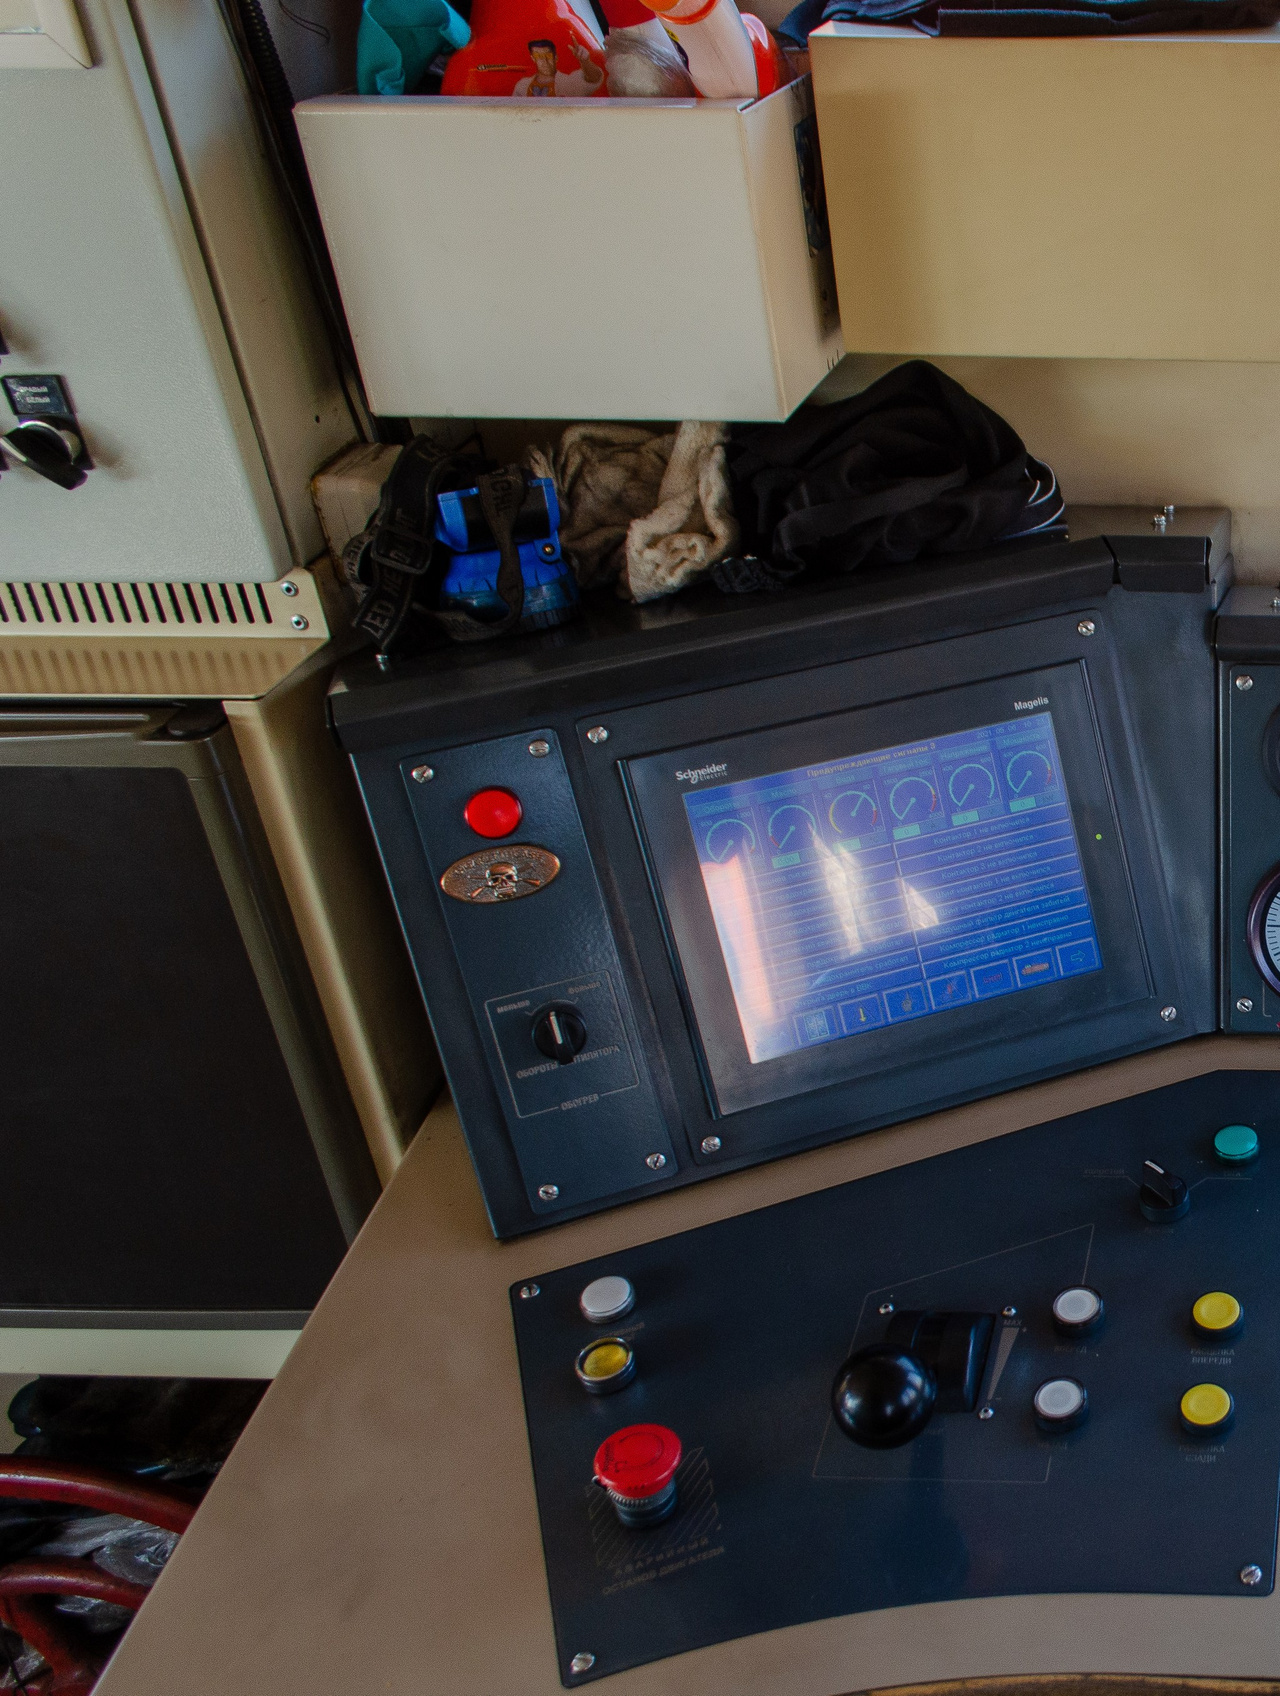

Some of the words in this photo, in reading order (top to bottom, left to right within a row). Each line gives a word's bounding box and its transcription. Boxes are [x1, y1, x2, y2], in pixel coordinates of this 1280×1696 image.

[1013, 696, 1049, 711] Magelis
[806, 752, 891, 778] Предупреждающие
[892, 744, 928, 758] сигналы
[929, 741, 936, 750] 3
[675, 763, 728, 784] Schneider
[700, 770, 728, 781] Electric
[933, 829, 971, 845] Контактор
[990, 816, 1030, 831] включился
[937, 847, 975, 863] Контактор
[993, 834, 1034, 848] включился
[941, 864, 979, 880] Контактор
[997, 850, 1037, 866] включился
[939, 934, 985, 953] Компрессор
[985, 926, 1019, 941] радиатор
[943, 951, 989, 970] Компрессор
[989, 943, 1023, 958] радиатор
[516, 1061, 559, 1079] ОБОРОТЫ
[560, 1093, 600, 1111] ОБОГРЕВ
[602, 1568, 657, 1596] ОСТАНОВ
[659, 1545, 726, 1578] ДВИГАТЕЛЯ
